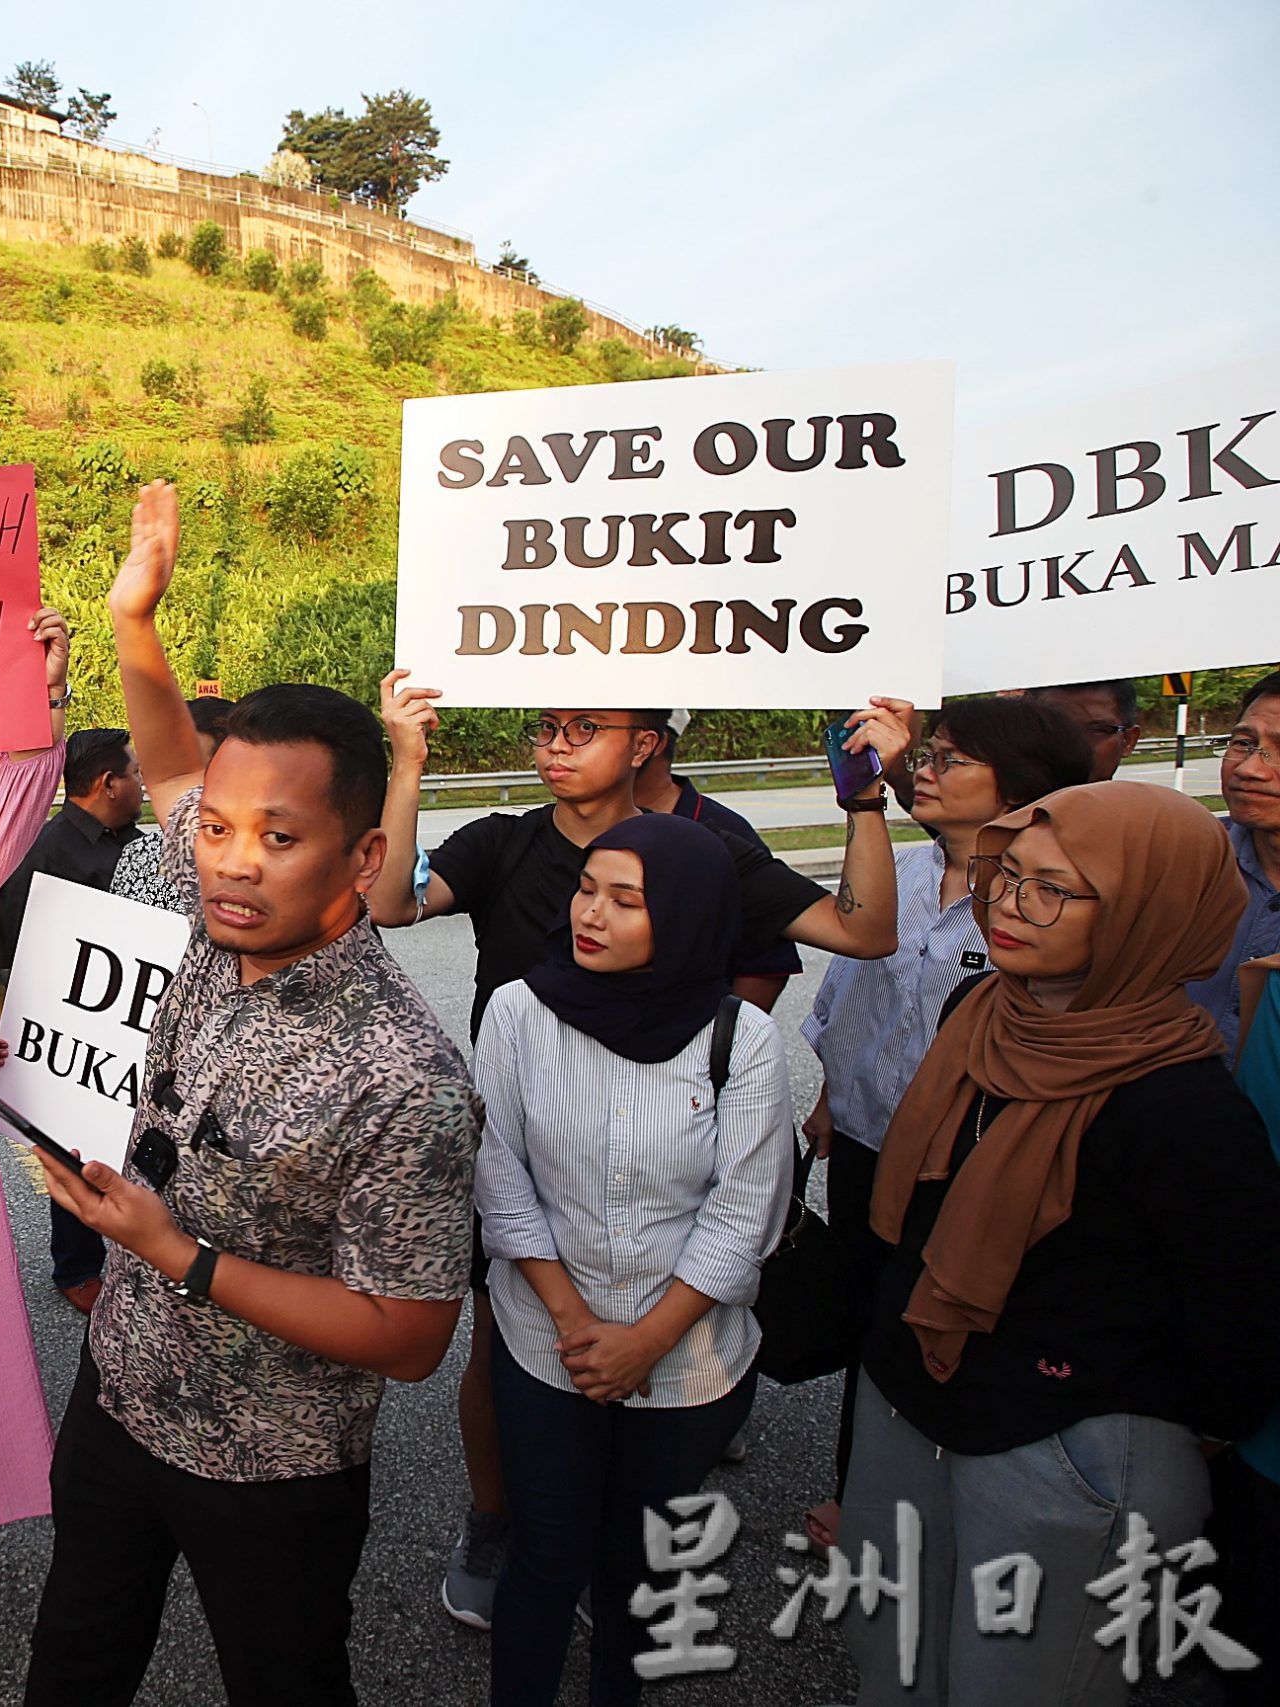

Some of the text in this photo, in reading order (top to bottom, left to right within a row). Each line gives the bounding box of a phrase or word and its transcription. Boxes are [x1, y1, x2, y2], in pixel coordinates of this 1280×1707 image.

[437, 412, 906, 489] SAVE OUR
[987, 410, 1280, 538] DBK
[501, 508, 797, 571] BUKIT
[945, 543, 1156, 615] BUKA
[454, 597, 870, 656] DINDING
[198, 684, 219, 695] AWAS
[14, 1017, 140, 1110] BUKA
